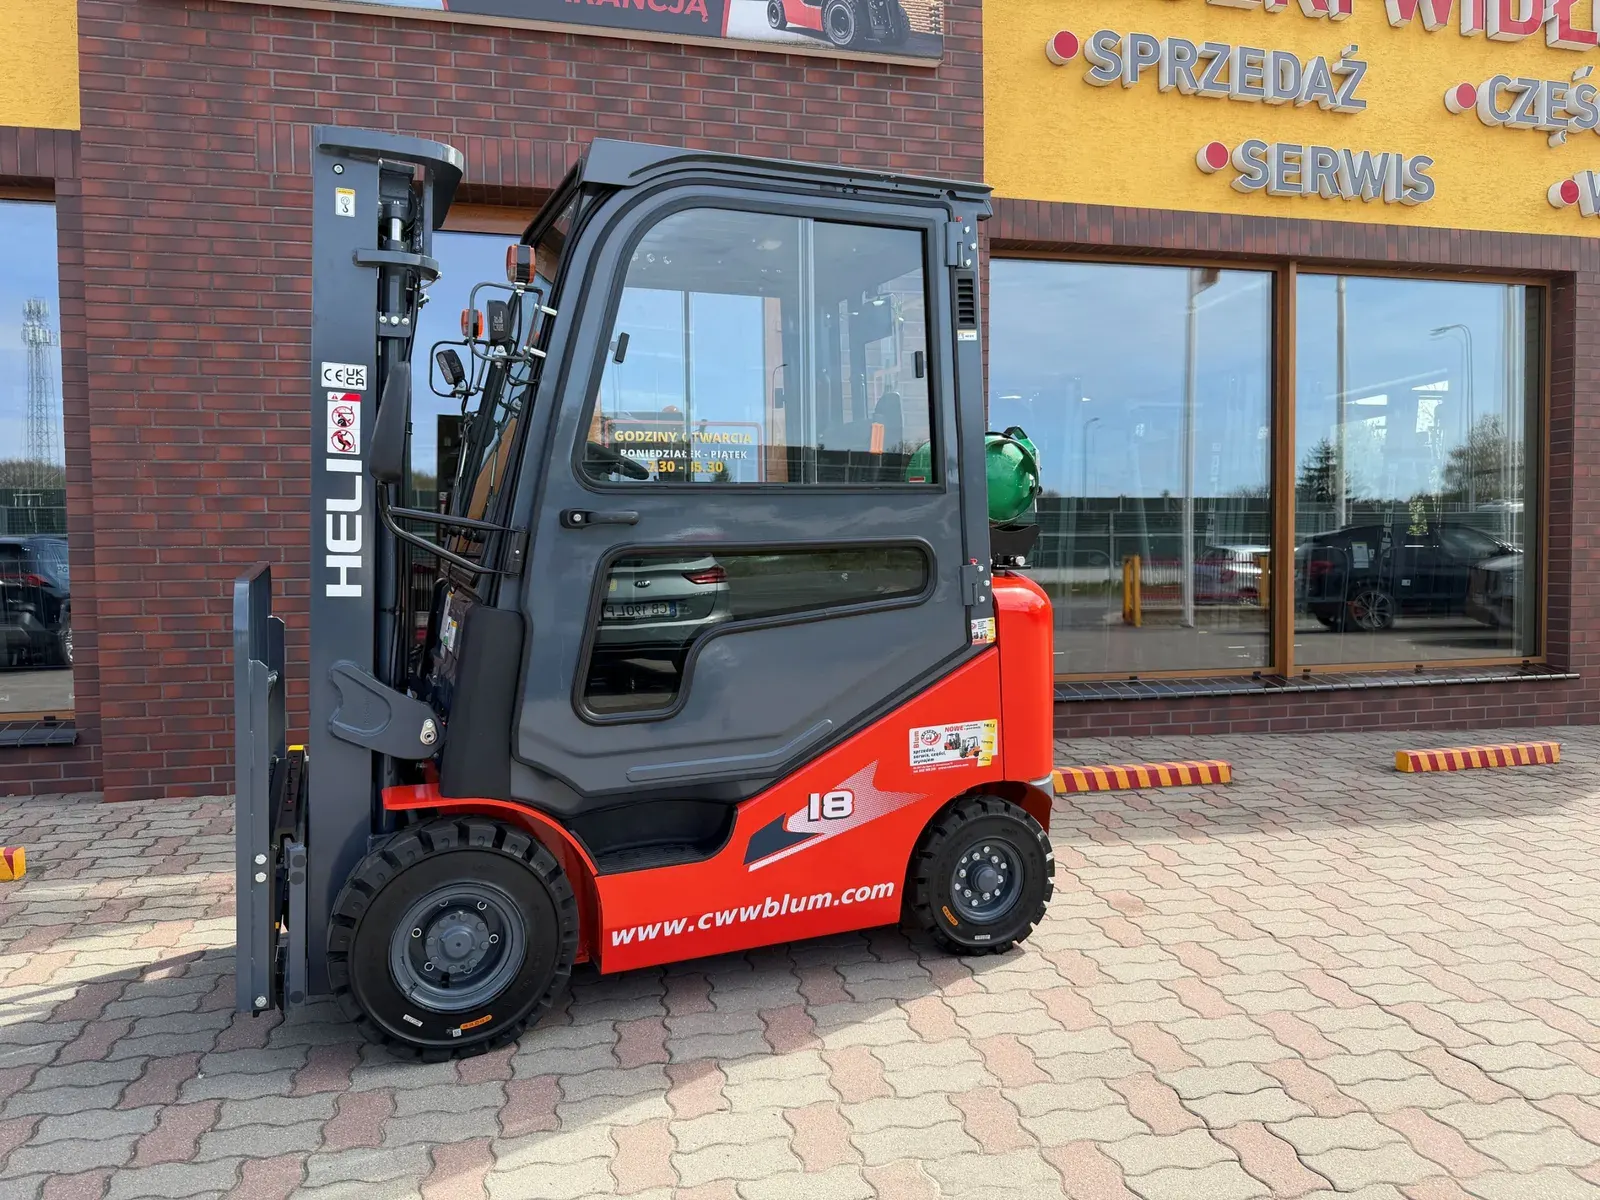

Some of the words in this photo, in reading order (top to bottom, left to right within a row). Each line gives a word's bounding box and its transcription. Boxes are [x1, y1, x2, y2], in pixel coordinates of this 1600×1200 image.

[1083, 29, 1368, 114] SPRZEDAŻ
[1477, 66, 1600, 147] CZĘŚ
[1231, 138, 1435, 206] SERWIS
[614, 430, 678, 442] GODZINY
[711, 450, 747, 461] PIĄTEK
[326, 459, 362, 597] HELI
[807, 789, 855, 822] 18
[610, 880, 895, 947] www.cwwblum.com
